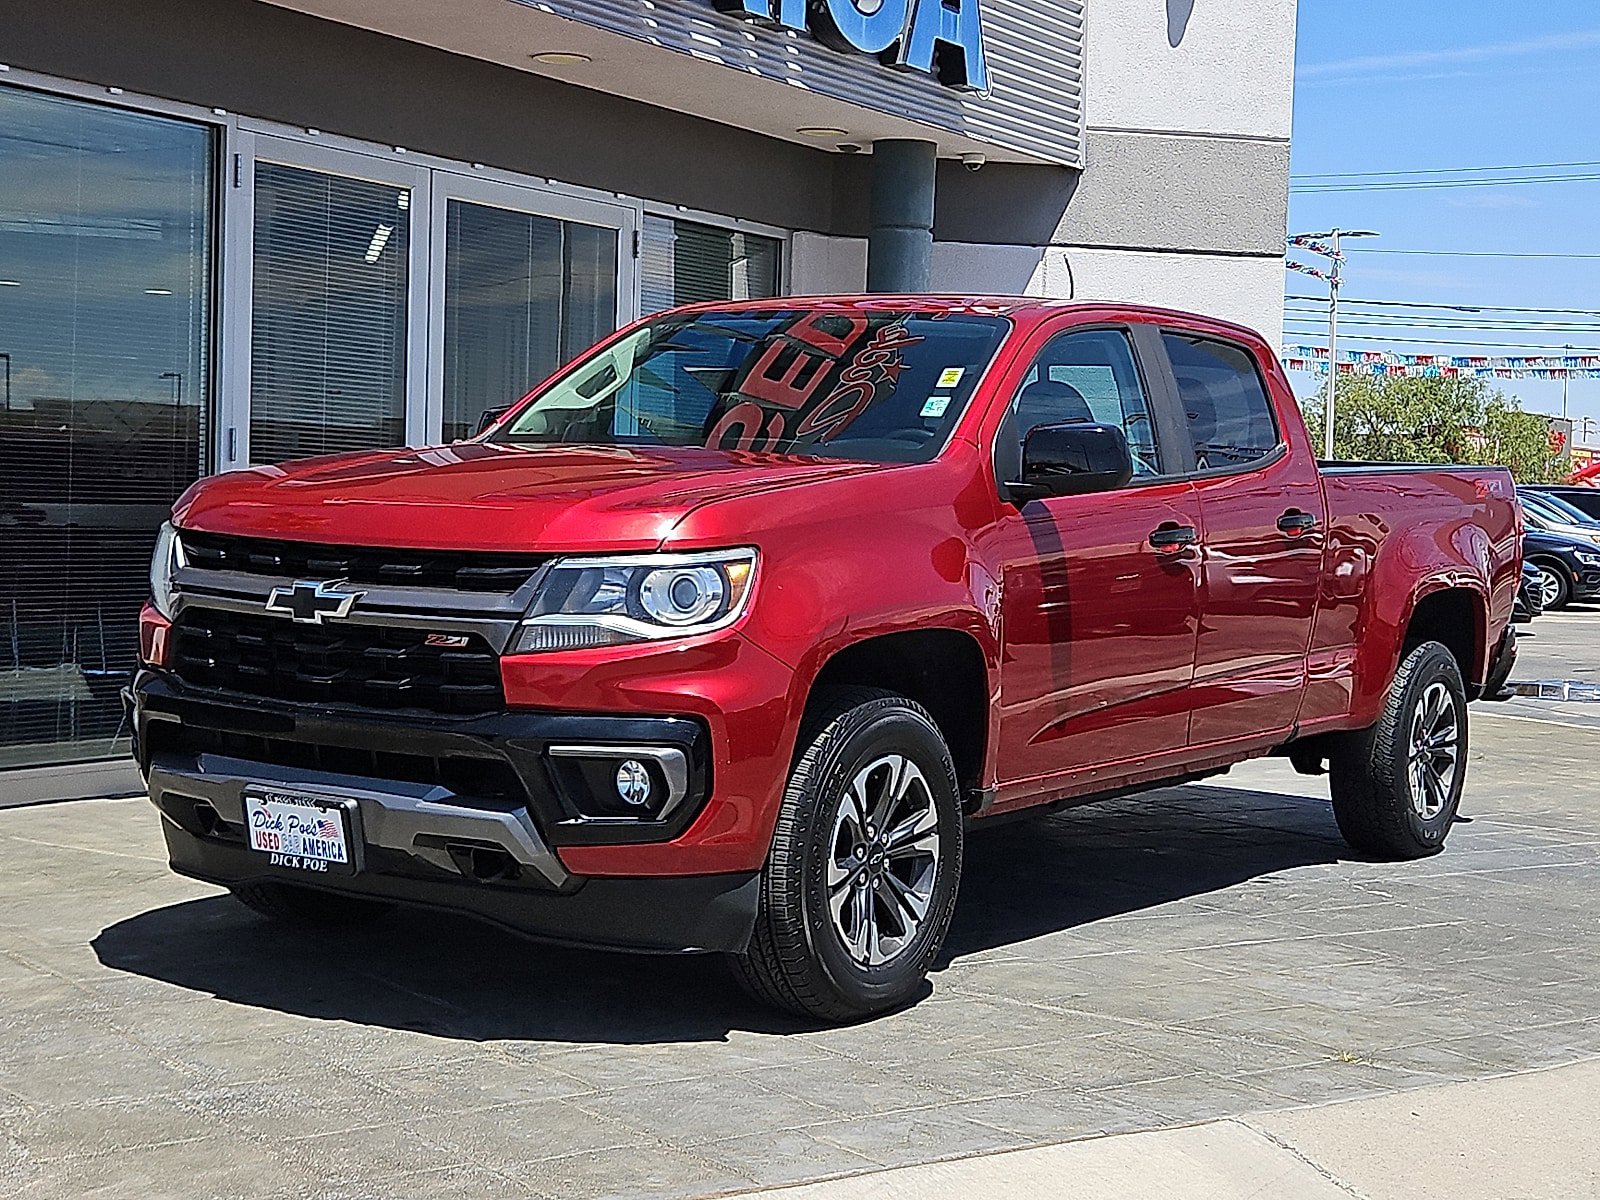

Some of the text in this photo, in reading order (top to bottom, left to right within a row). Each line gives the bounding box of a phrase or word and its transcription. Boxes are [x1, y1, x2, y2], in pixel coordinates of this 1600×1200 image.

[424, 633, 470, 647] Z71
[252, 810, 318, 837] Dick Poe's
[255, 830, 280, 851] USED
[302, 836, 345, 860] AMERICA
[270, 853, 328, 872] DICK POE
